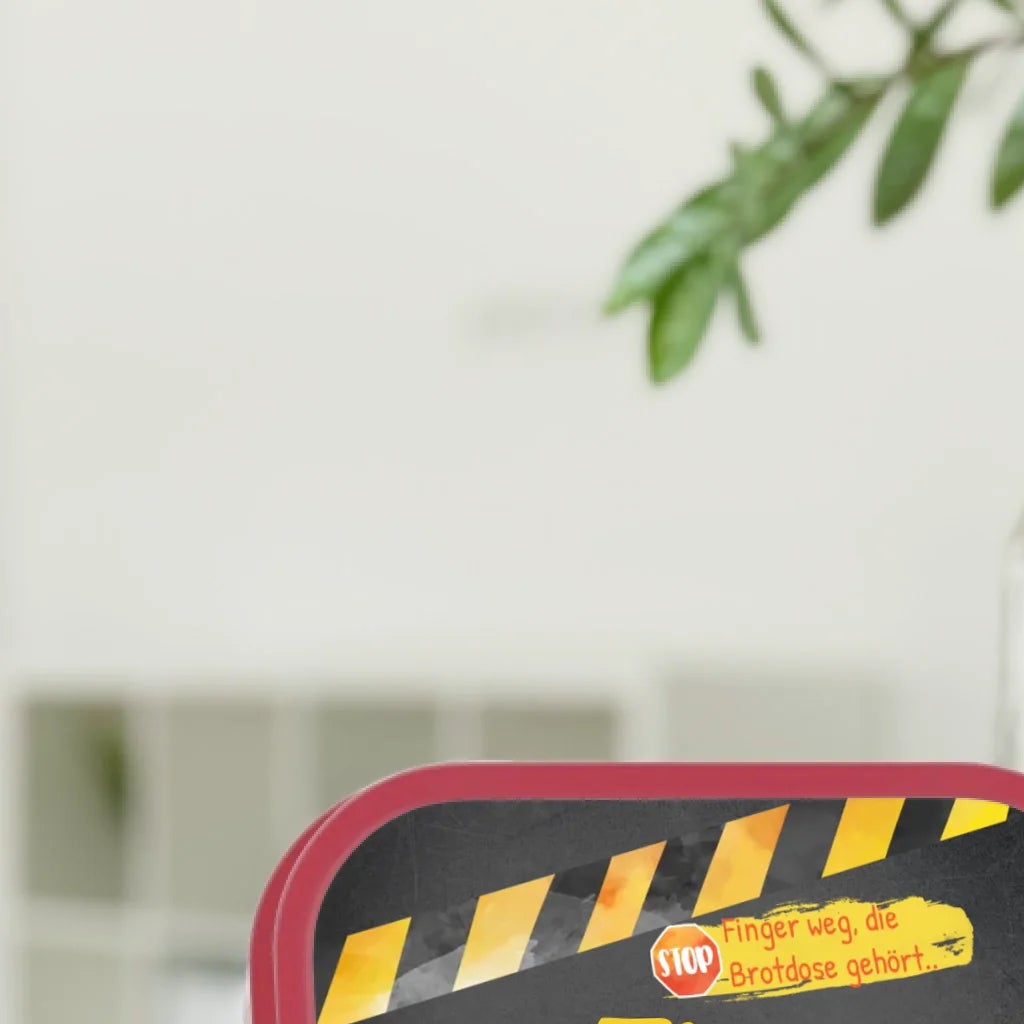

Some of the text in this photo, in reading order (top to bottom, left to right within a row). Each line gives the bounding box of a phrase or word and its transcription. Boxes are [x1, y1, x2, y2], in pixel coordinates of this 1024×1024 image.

[721, 905, 899, 951] Finger weg, die
[657, 944, 714, 978] STOP
[729, 944, 939, 989] Brotdose gehört..
